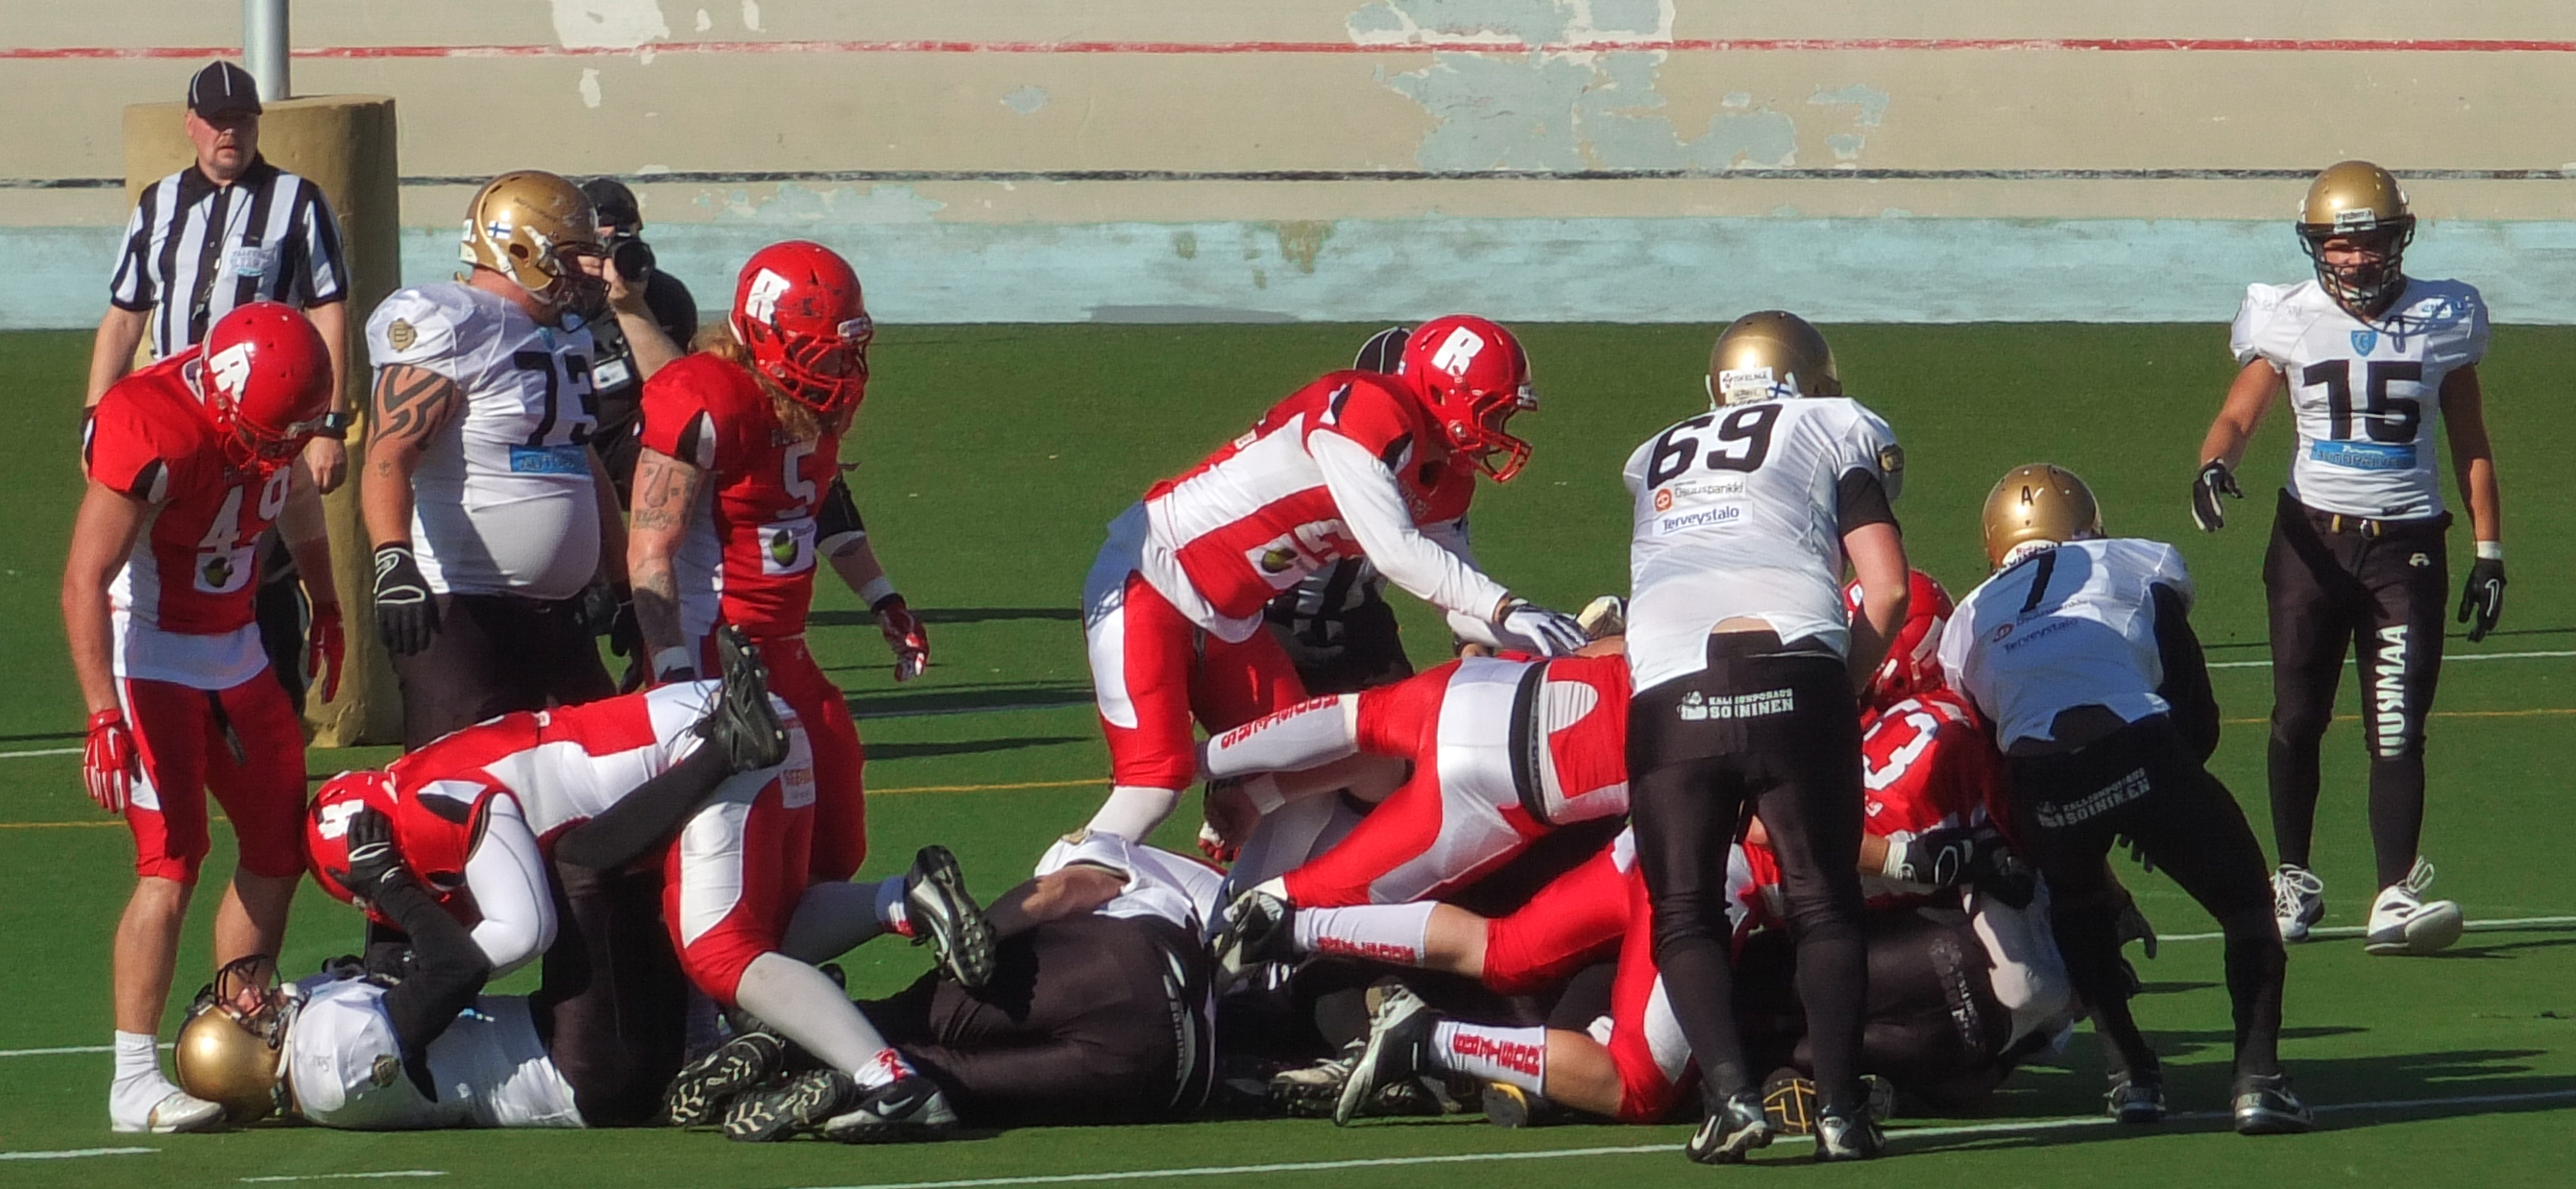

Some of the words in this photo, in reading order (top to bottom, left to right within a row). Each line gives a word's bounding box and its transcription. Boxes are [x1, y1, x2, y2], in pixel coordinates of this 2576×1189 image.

[745, 268, 790, 325] R
[208, 343, 251, 403] R
[1431, 326, 1485, 377] R
[512, 351, 598, 447] 73
[2302, 358, 2422, 443] 15
[776, 439, 816, 520] 5
[1647, 403, 1784, 491] 69
[199, 466, 291, 554] 49
[1663, 506, 1739, 530] Terveystalo
[2021, 485, 2033, 506] A
[1997, 548, 2056, 614] 7
